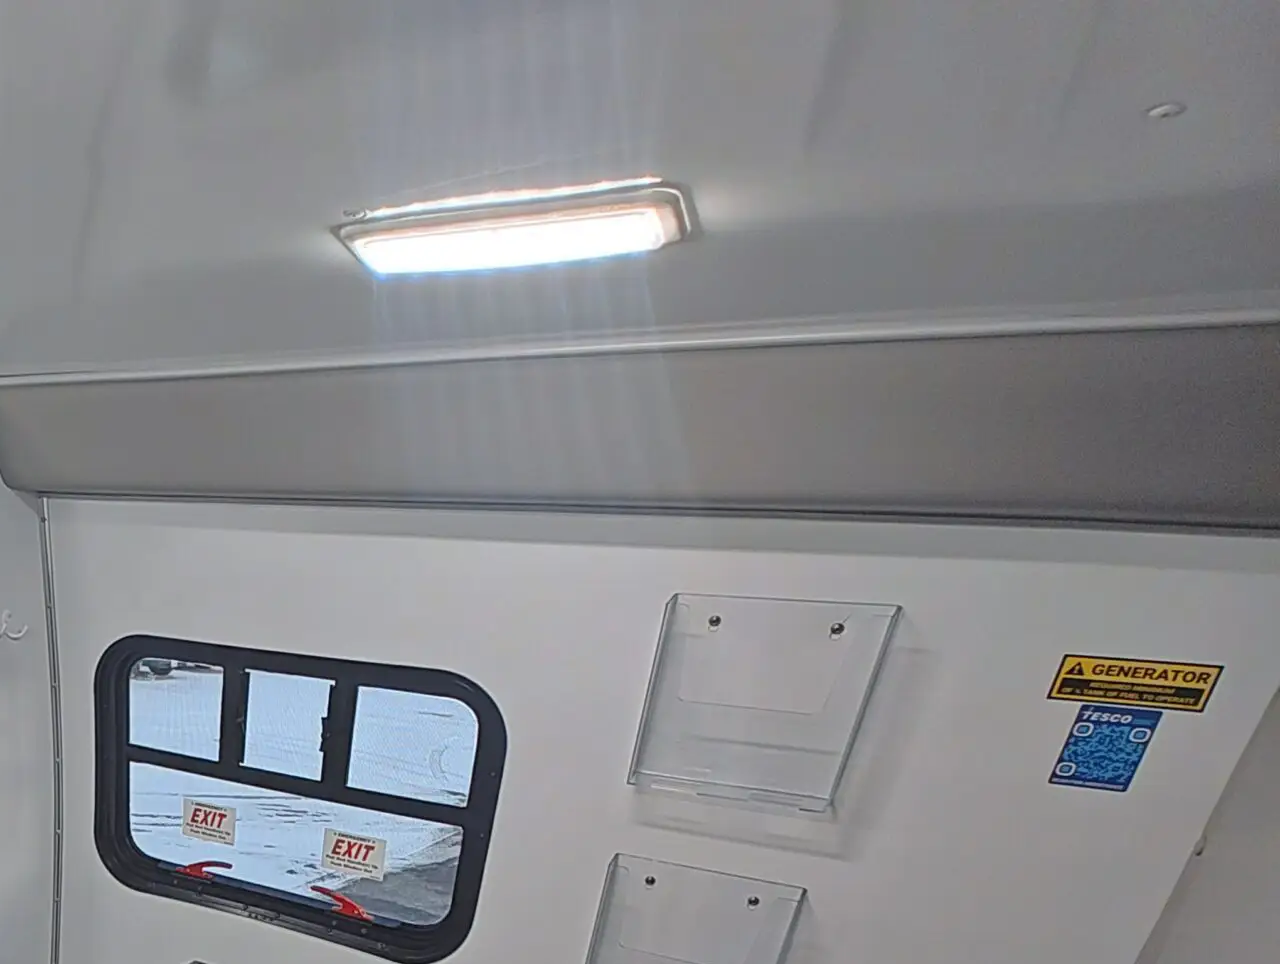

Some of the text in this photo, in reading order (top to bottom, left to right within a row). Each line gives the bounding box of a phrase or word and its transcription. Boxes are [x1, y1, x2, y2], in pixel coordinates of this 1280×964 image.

[1091, 663, 1212, 685] GENERATOR
[1081, 708, 1133, 724] TESCO
[190, 807, 227, 829] EXIT
[331, 838, 376, 862] EXIT
